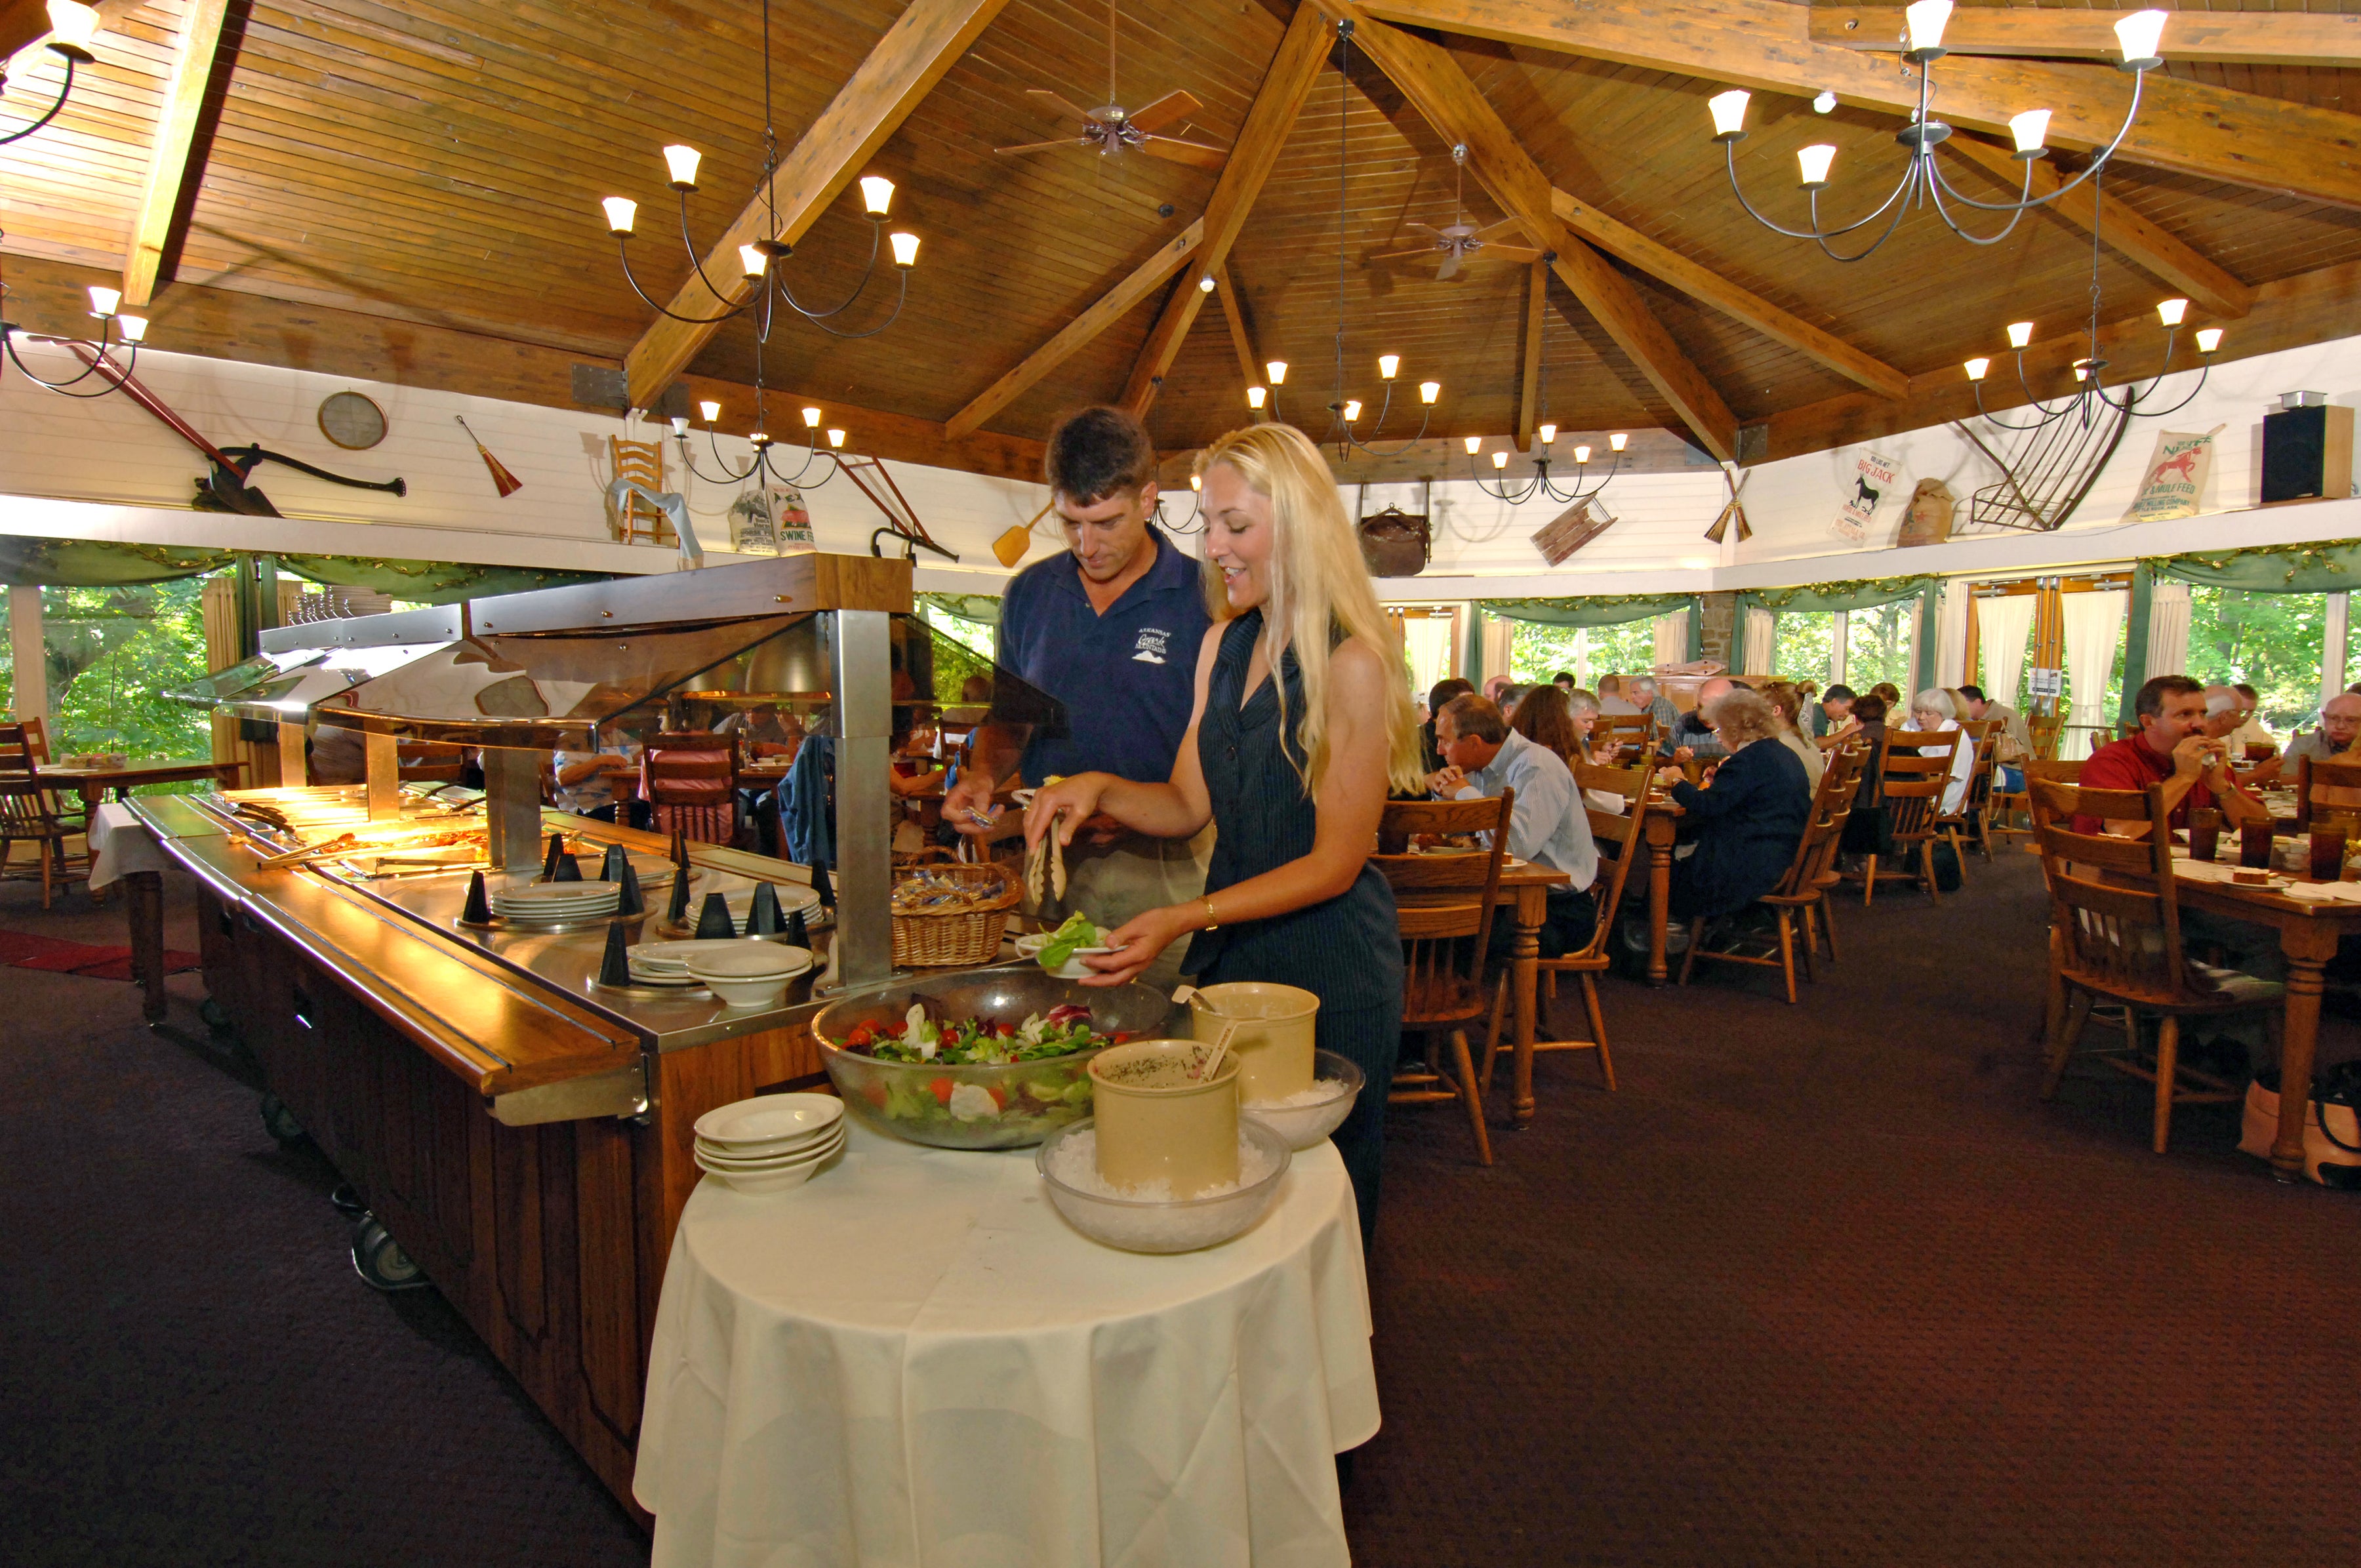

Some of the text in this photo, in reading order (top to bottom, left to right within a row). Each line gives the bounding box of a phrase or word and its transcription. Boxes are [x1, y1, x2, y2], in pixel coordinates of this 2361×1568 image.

[1857, 459, 1895, 483] BIG JACK
[2177, 483, 2196, 494] FEED
[780, 530, 806, 541] SWINE
[1138, 633, 1165, 649] Ozark
